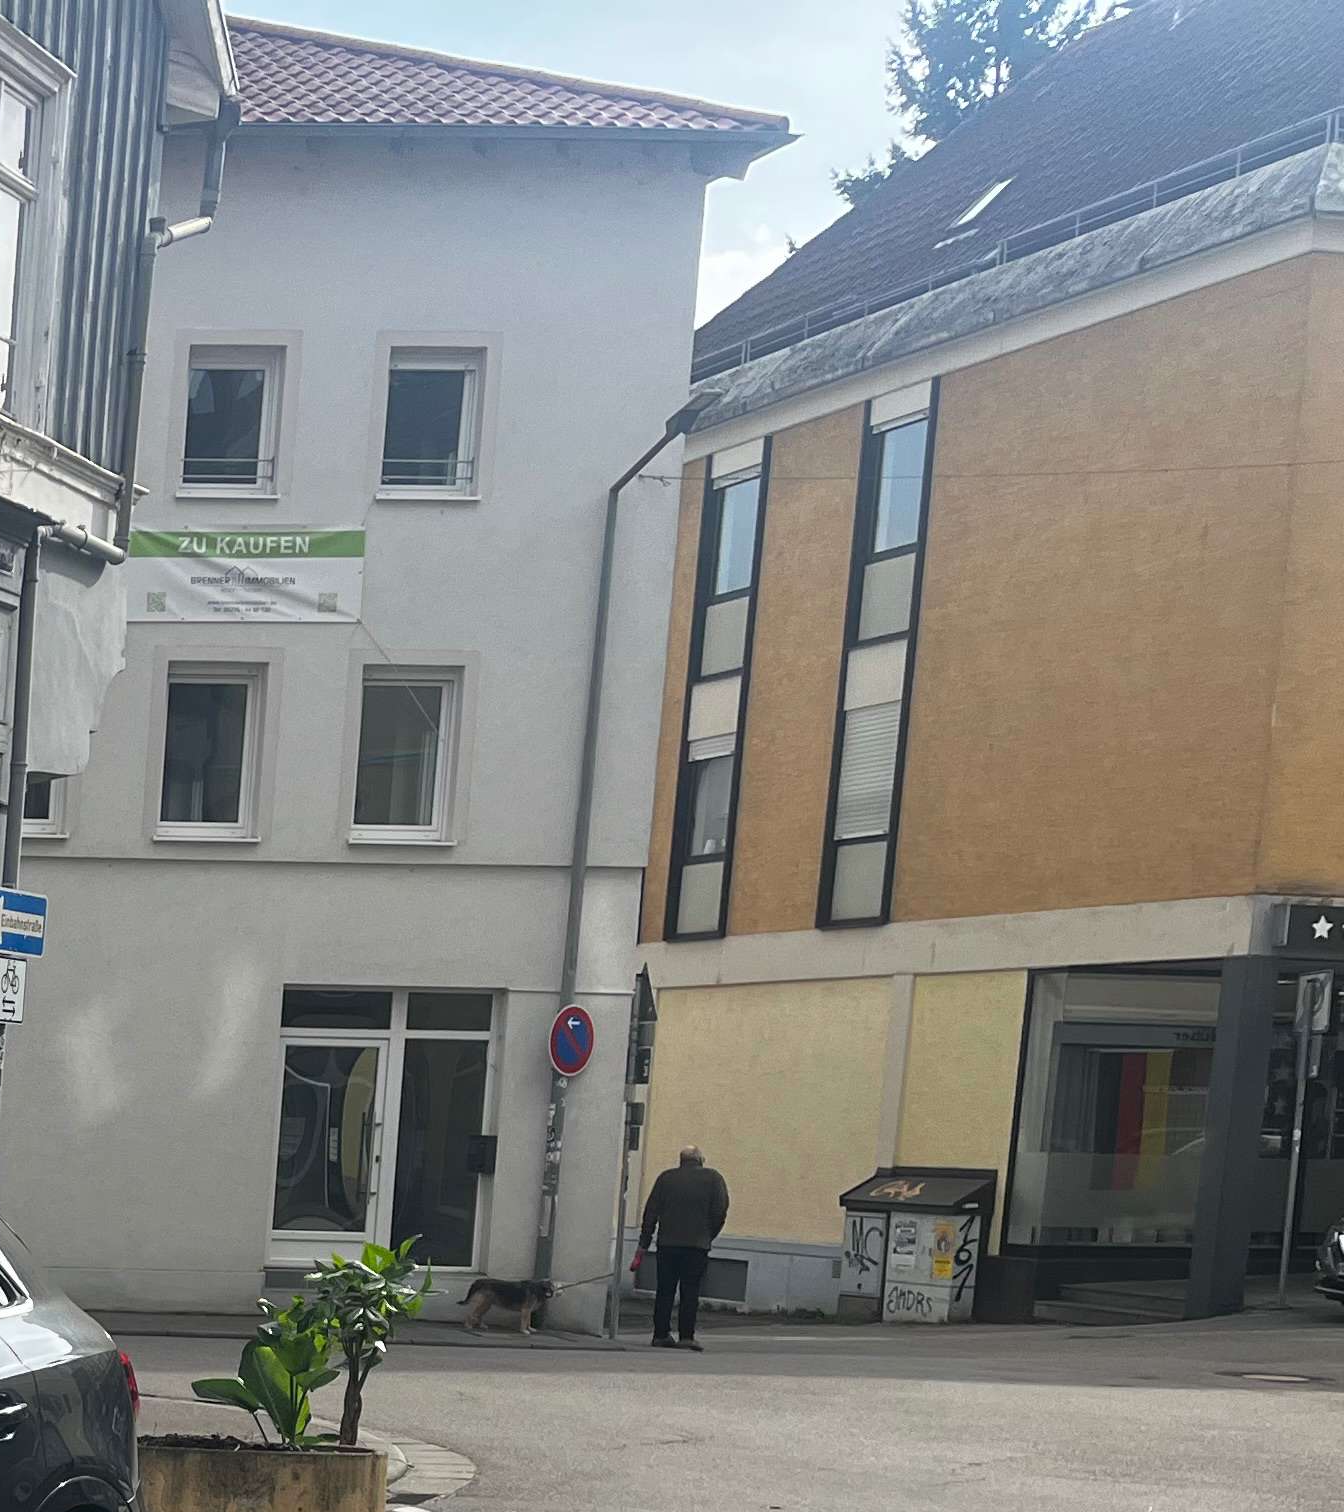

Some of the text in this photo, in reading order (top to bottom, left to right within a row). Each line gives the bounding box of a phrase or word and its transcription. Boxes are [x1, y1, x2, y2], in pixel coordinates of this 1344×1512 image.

[178, 536, 310, 554] ZU KAUFEN
[190, 576, 231, 585] BRENNER
[1, 913, 42, 933] Einbahnstraße
